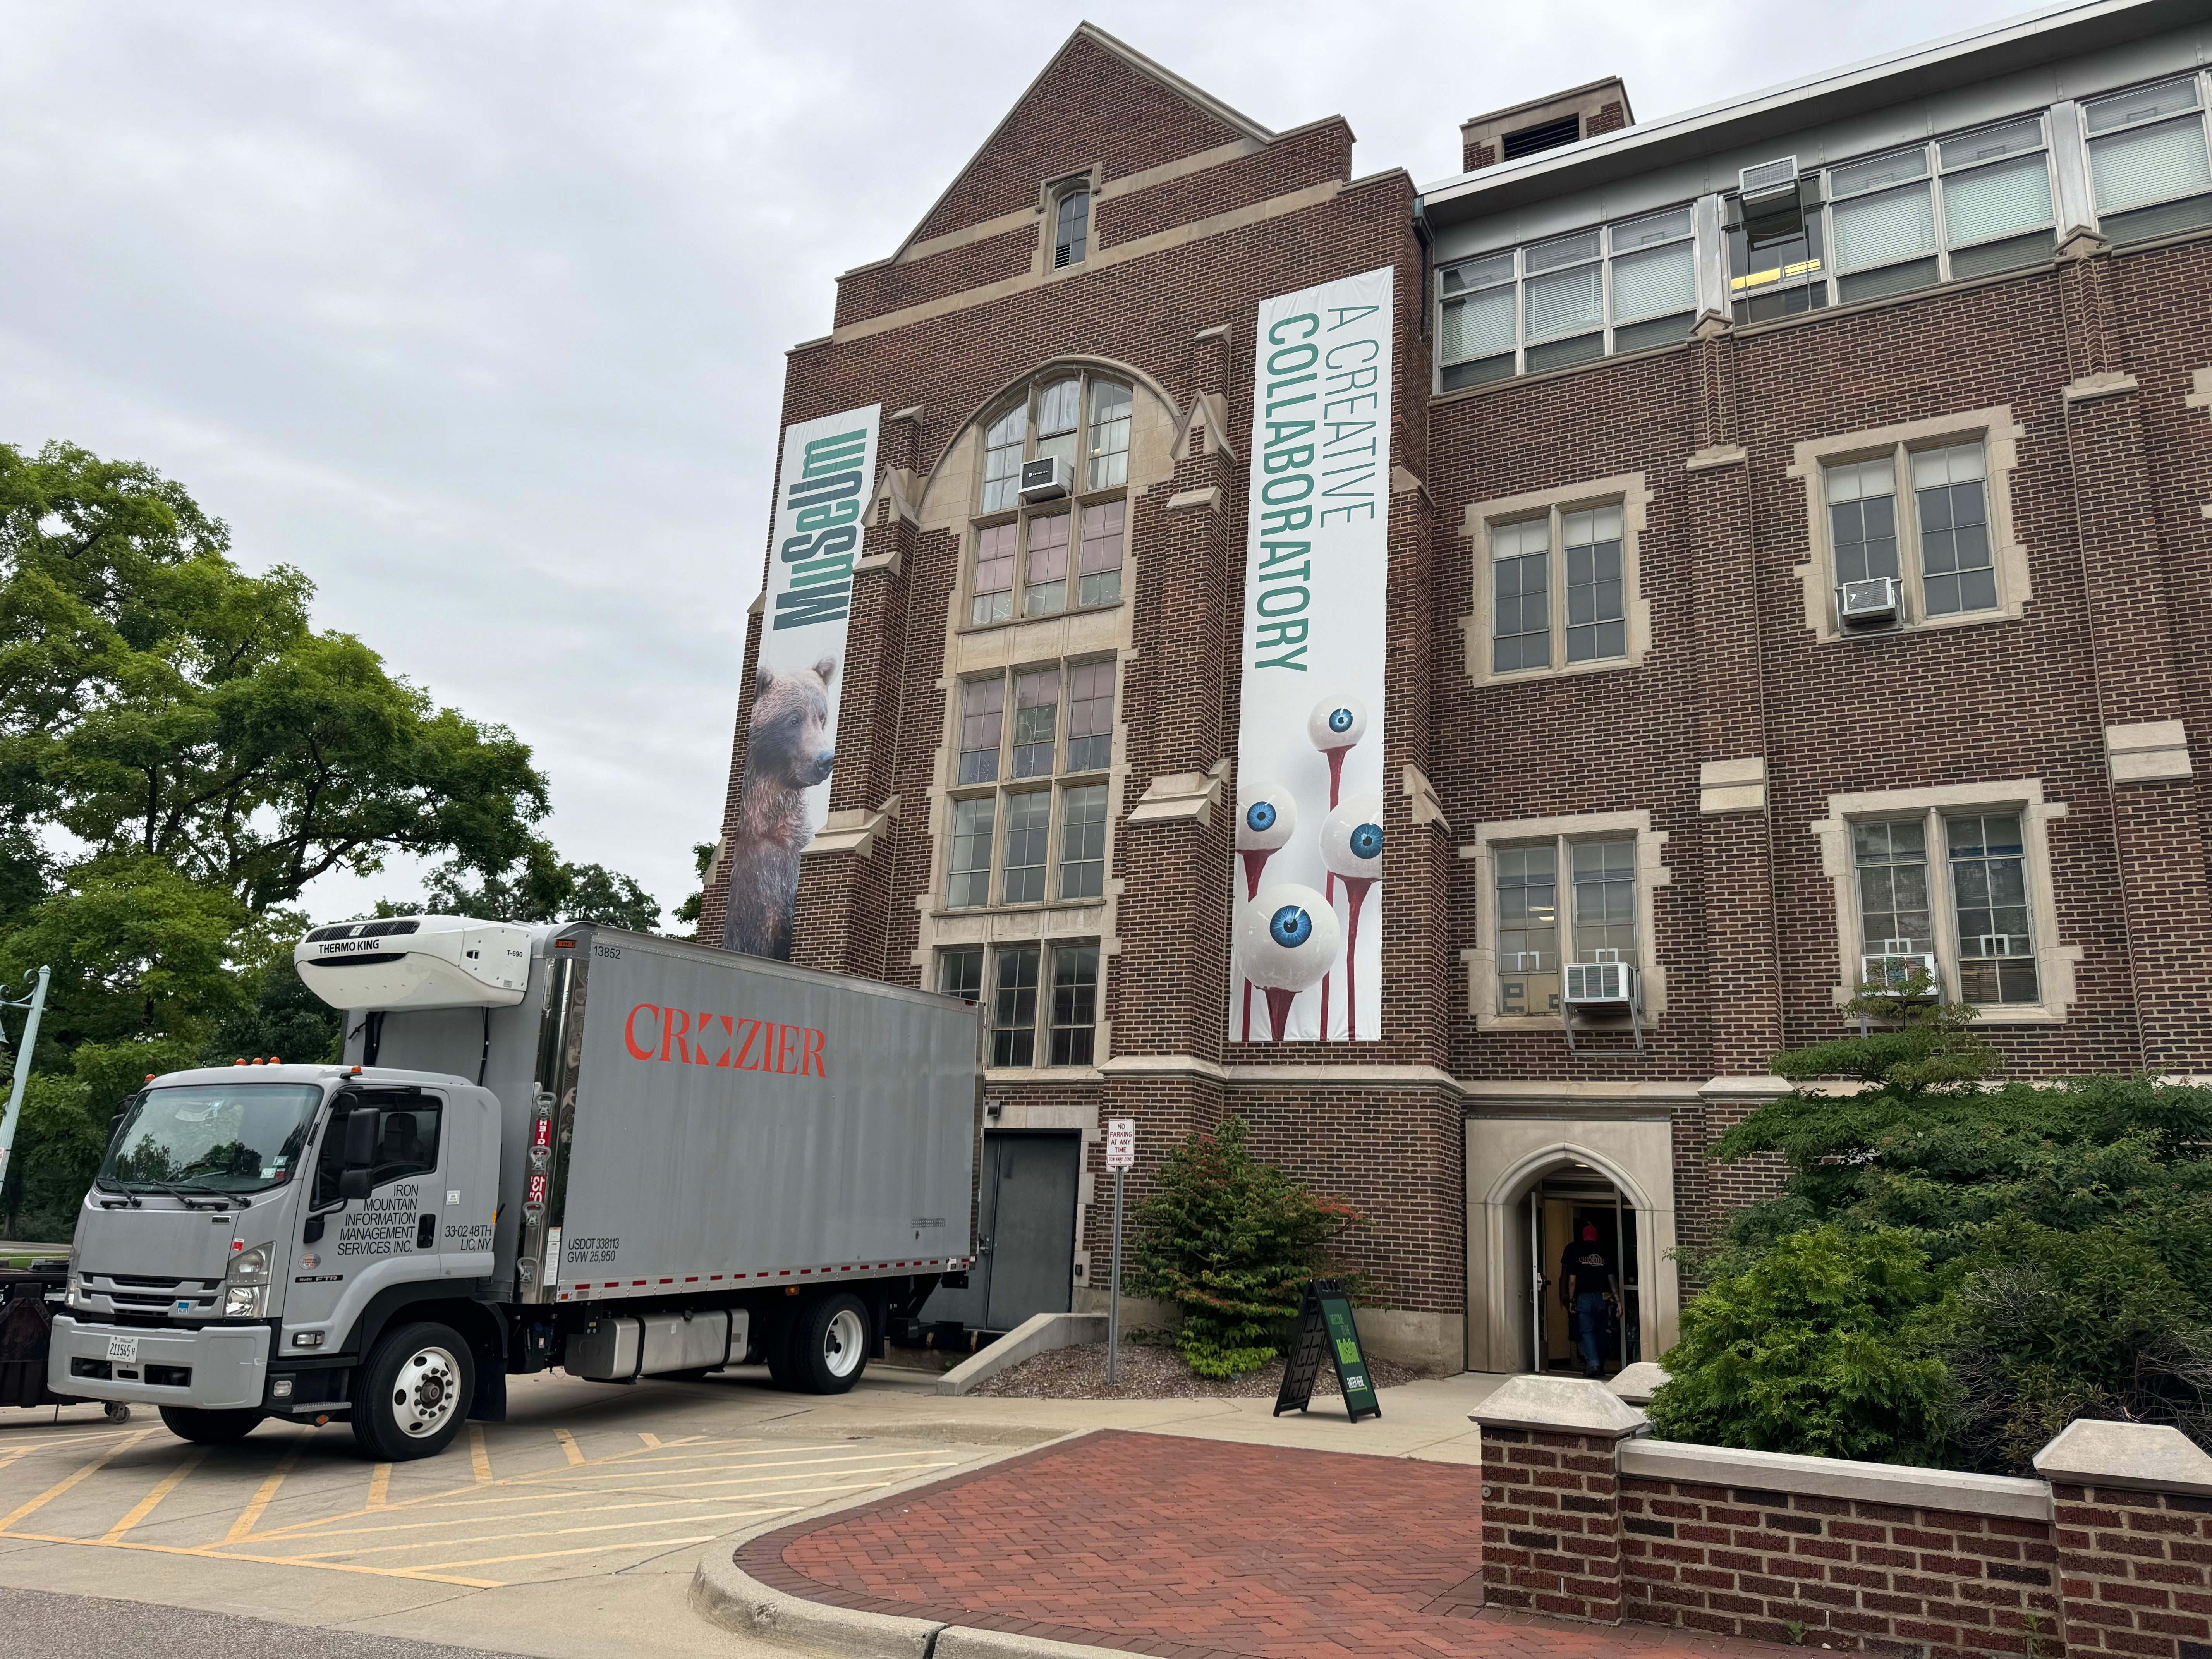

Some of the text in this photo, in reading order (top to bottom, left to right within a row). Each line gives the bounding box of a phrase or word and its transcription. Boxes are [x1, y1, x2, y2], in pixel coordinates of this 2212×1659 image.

[1320, 305, 1379, 528] A CREATIVE
[1255, 313, 1320, 672] COLLABORATORY
[319, 939, 380, 954] THERMO KING
[594, 946, 620, 959] 13852
[394, 1184, 418, 1197] IRON
[364, 1198, 417, 1211] MOUNTAIN
[345, 1212, 416, 1226] INFORMATION
[340, 1226, 416, 1241] MANAGEMENT
[445, 1224, 492, 1237] 33-02 48TH
[337, 1240, 412, 1255] SERVICES, INC.
[461, 1238, 491, 1252] LIC, NY
[568, 1238, 619, 1250] USDOT 338113
[567, 1250, 615, 1263] GVW 25,950
[110, 1343, 135, 1357] 211545 H
